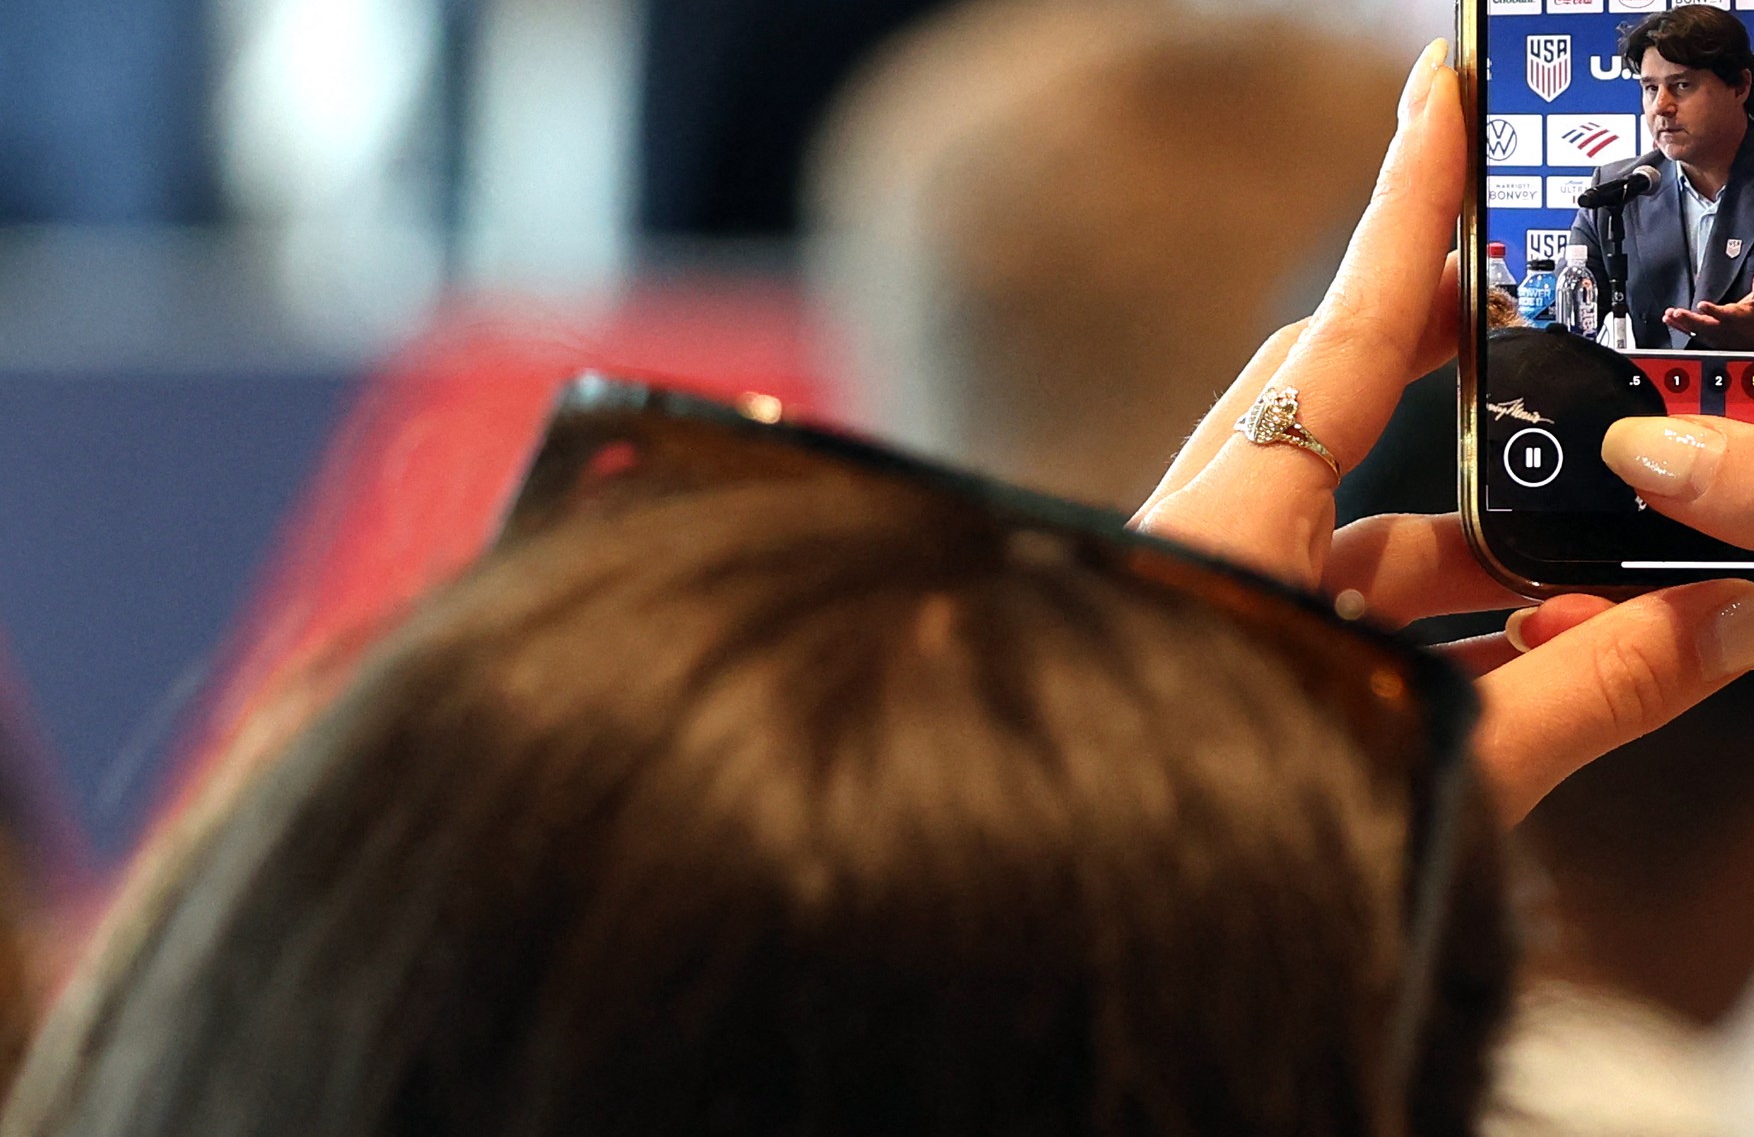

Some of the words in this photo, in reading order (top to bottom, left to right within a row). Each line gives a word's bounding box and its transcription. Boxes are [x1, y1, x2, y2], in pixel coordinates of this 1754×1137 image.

[1530, 39, 1568, 63] USA
[1489, 190, 1538, 200] BONVOY
[1628, 376, 1641, 386] .5
[1715, 376, 1723, 386] 2
